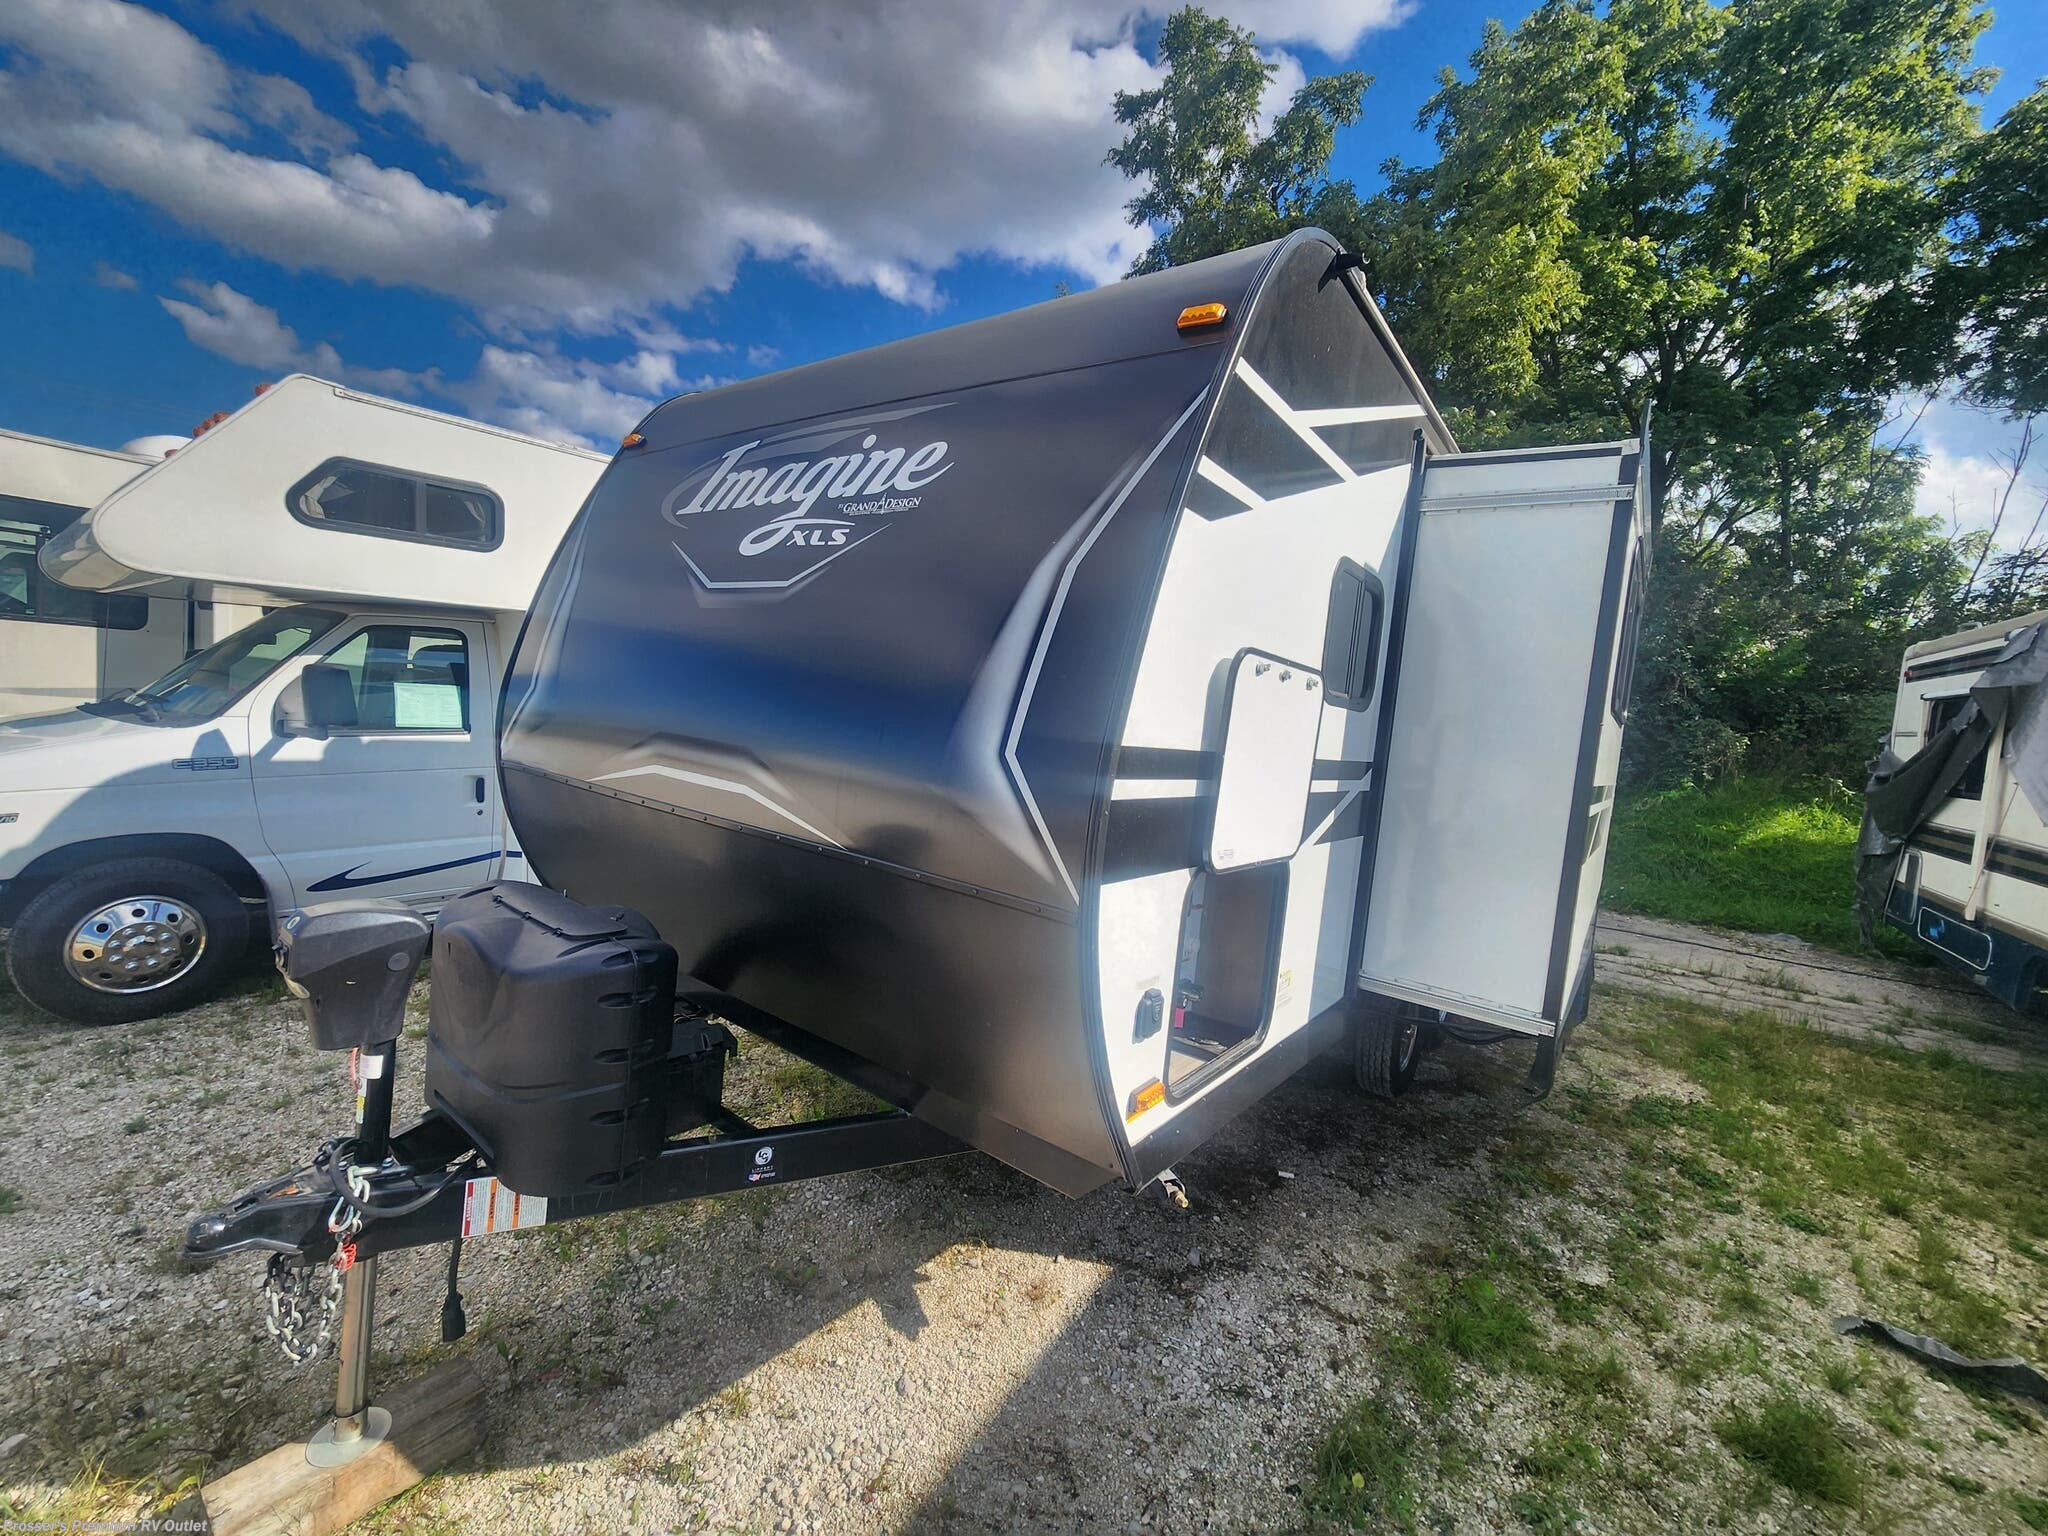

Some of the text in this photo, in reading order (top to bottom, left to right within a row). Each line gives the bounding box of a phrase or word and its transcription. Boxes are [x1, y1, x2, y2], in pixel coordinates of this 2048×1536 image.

[675, 434, 955, 556] Imagine
[884, 496, 922, 509] DESIGN
[786, 528, 850, 546] XLS
